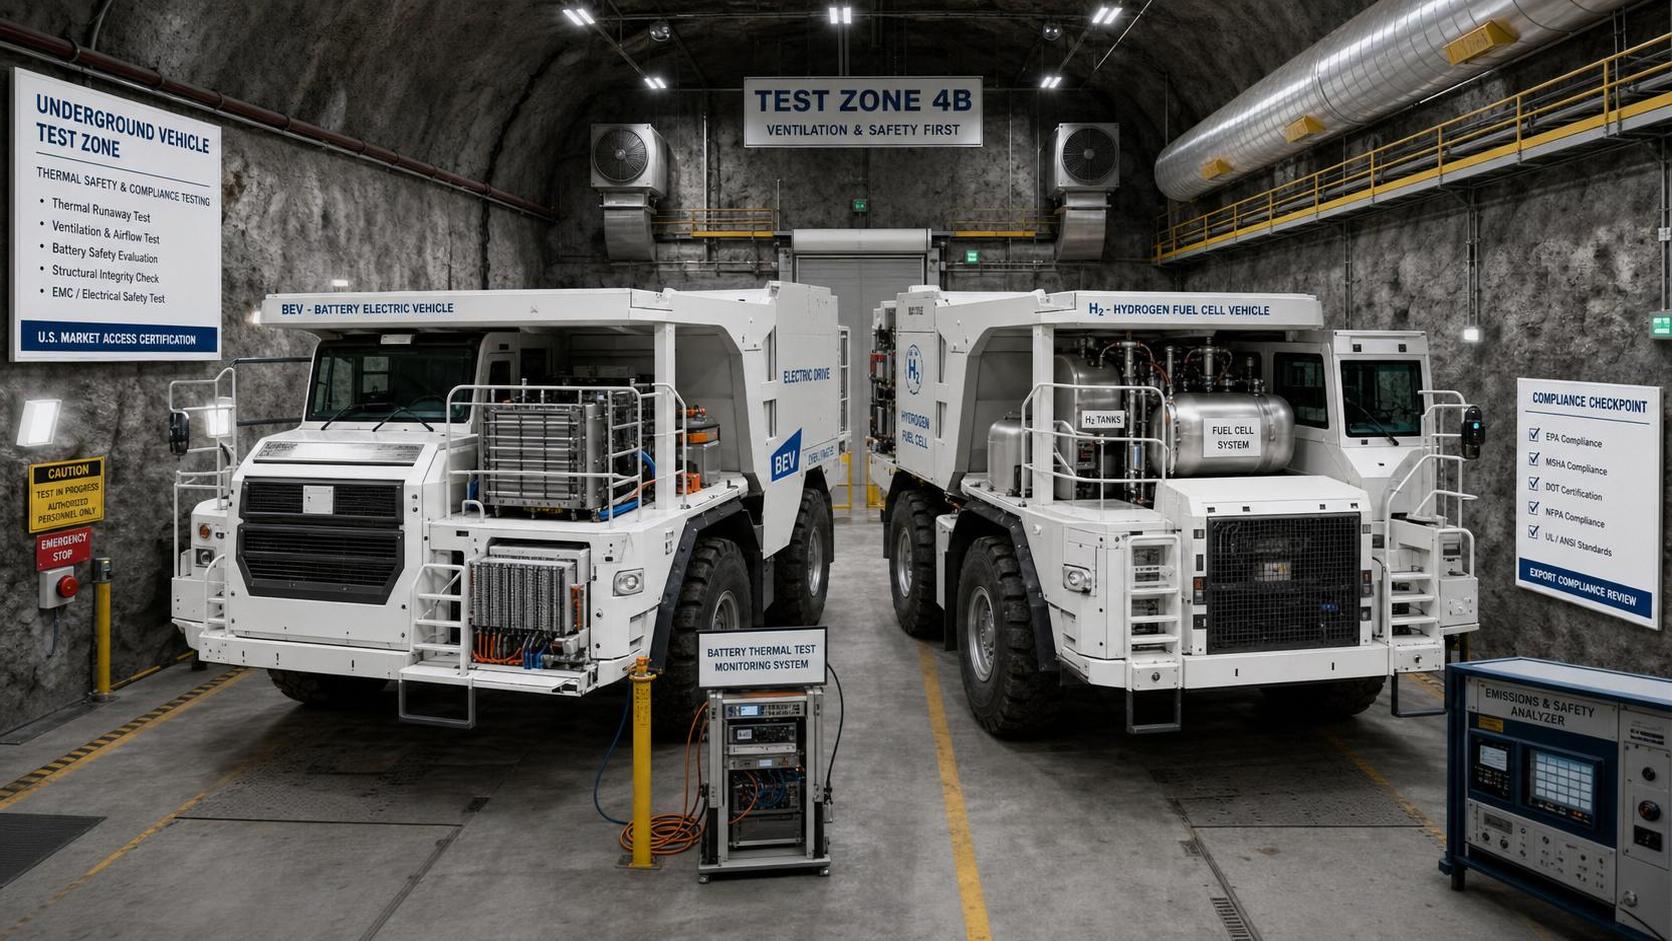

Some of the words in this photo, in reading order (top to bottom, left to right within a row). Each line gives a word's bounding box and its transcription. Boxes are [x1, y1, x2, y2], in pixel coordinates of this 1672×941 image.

[755, 89, 829, 112] TEST
[839, 89, 921, 112] ZONE
[932, 89, 972, 112] 4B
[37, 93, 155, 140] UNDERGROUND
[158, 126, 210, 154] VEHICLE
[767, 124, 848, 136] VENTILATION
[853, 124, 863, 136] &
[869, 124, 918, 136] SAFETY
[924, 124, 960, 135] FIRST
[36, 122, 77, 148] TEST
[81, 134, 120, 158] ZONE
[37, 167, 81, 186] THERMAL
[84, 175, 118, 191] SAFETY
[120, 182, 127, 192] &
[129, 184, 180, 202] COMPLIANCE
[181, 193, 210, 207] TESTING
[52, 198, 90, 214] Thermal
[93, 203, 131, 222] Runaway
[134, 211, 151, 223] Test
[52, 221, 101, 237] Ventilation
[104, 227, 111, 238] &
[113, 229, 142, 243] Airflow
[144, 233, 160, 245] Test
[52, 243, 86, 259] Battery
[89, 248, 116, 262] Safety
[118, 251, 158, 263] Evaluation
[52, 265, 97, 280] Structural
[100, 269, 134, 283] Integrity
[136, 273, 159, 284] Check
[52, 287, 73, 299] EMC
[82, 289, 120, 301] Electrical
[123, 291, 148, 304] Safety
[150, 294, 165, 304] Test
[282, 304, 303, 315] BEV
[314, 304, 359, 315] BATTERY
[363, 304, 410, 314] ELECTRIC
[413, 303, 453, 313] VEHICLE
[1114, 304, 1169, 315] HYDROGEN
[1173, 305, 1198, 315] FUEL
[1201, 305, 1225, 315] CELL
[1229, 305, 1270, 315] VEHICLE
[38, 330, 58, 343] U.S.
[61, 332, 100, 344] MARKET
[103, 333, 137, 344] ACCESS
[139, 334, 196, 345] CERTIFICATION
[784, 369, 812, 384] ELECTRIC
[813, 367, 830, 381] DRIVE
[1532, 392, 1586, 408] COMPLIANCE
[1589, 396, 1647, 413] CHECKPOINT
[1096, 415, 1121, 424] TANKS
[1212, 427, 1232, 435] FUEL
[1234, 426, 1254, 435] CELL
[902, 431, 913, 443] FUEL
[915, 434, 928, 449] CELL
[1218, 440, 1249, 449] SYSTEM
[1546, 432, 1559, 442] EPA
[1561, 435, 1603, 448] Compliance
[48, 464, 89, 479] CAUTION
[775, 450, 795, 475] BEV
[1546, 458, 1565, 469] MSHA
[1567, 462, 1608, 476] Compliance
[37, 490, 53, 499] TEST
[56, 488, 63, 496] IN
[65, 483, 99, 494] PROGRESS
[1546, 482, 1559, 492] DOT
[1561, 486, 1603, 501] Certification
[48, 498, 88, 511] AUTHORIZED
[38, 511, 77, 524] PERSONNEL
[80, 507, 96, 517] ONLY
[1546, 507, 1563, 518] NFPA
[1565, 512, 1605, 528] Compliance
[41, 532, 87, 550] EMERGENCY
[1545, 532, 1554, 542] UL
[1559, 536, 1576, 548] ANSI
[1577, 540, 1612, 557] Standards
[53, 550, 73, 561] STOP
[1530, 567, 1556, 583] EXPORT
[1558, 575, 1605, 597] COMPLIANCE
[1607, 590, 1636, 606] REVIEW
[708, 647, 747, 657] BATTERY
[749, 646, 792, 656] THERMAL
[794, 644, 816, 655] TEST
[715, 661, 771, 672] MONITORING
[773, 659, 808, 670] SYSTEM
[1485, 687, 1539, 707] EMISSIONS
[1542, 698, 1550, 708] &
[1553, 700, 1595, 718] SAFETY
[1511, 706, 1565, 726] ANALYZER
